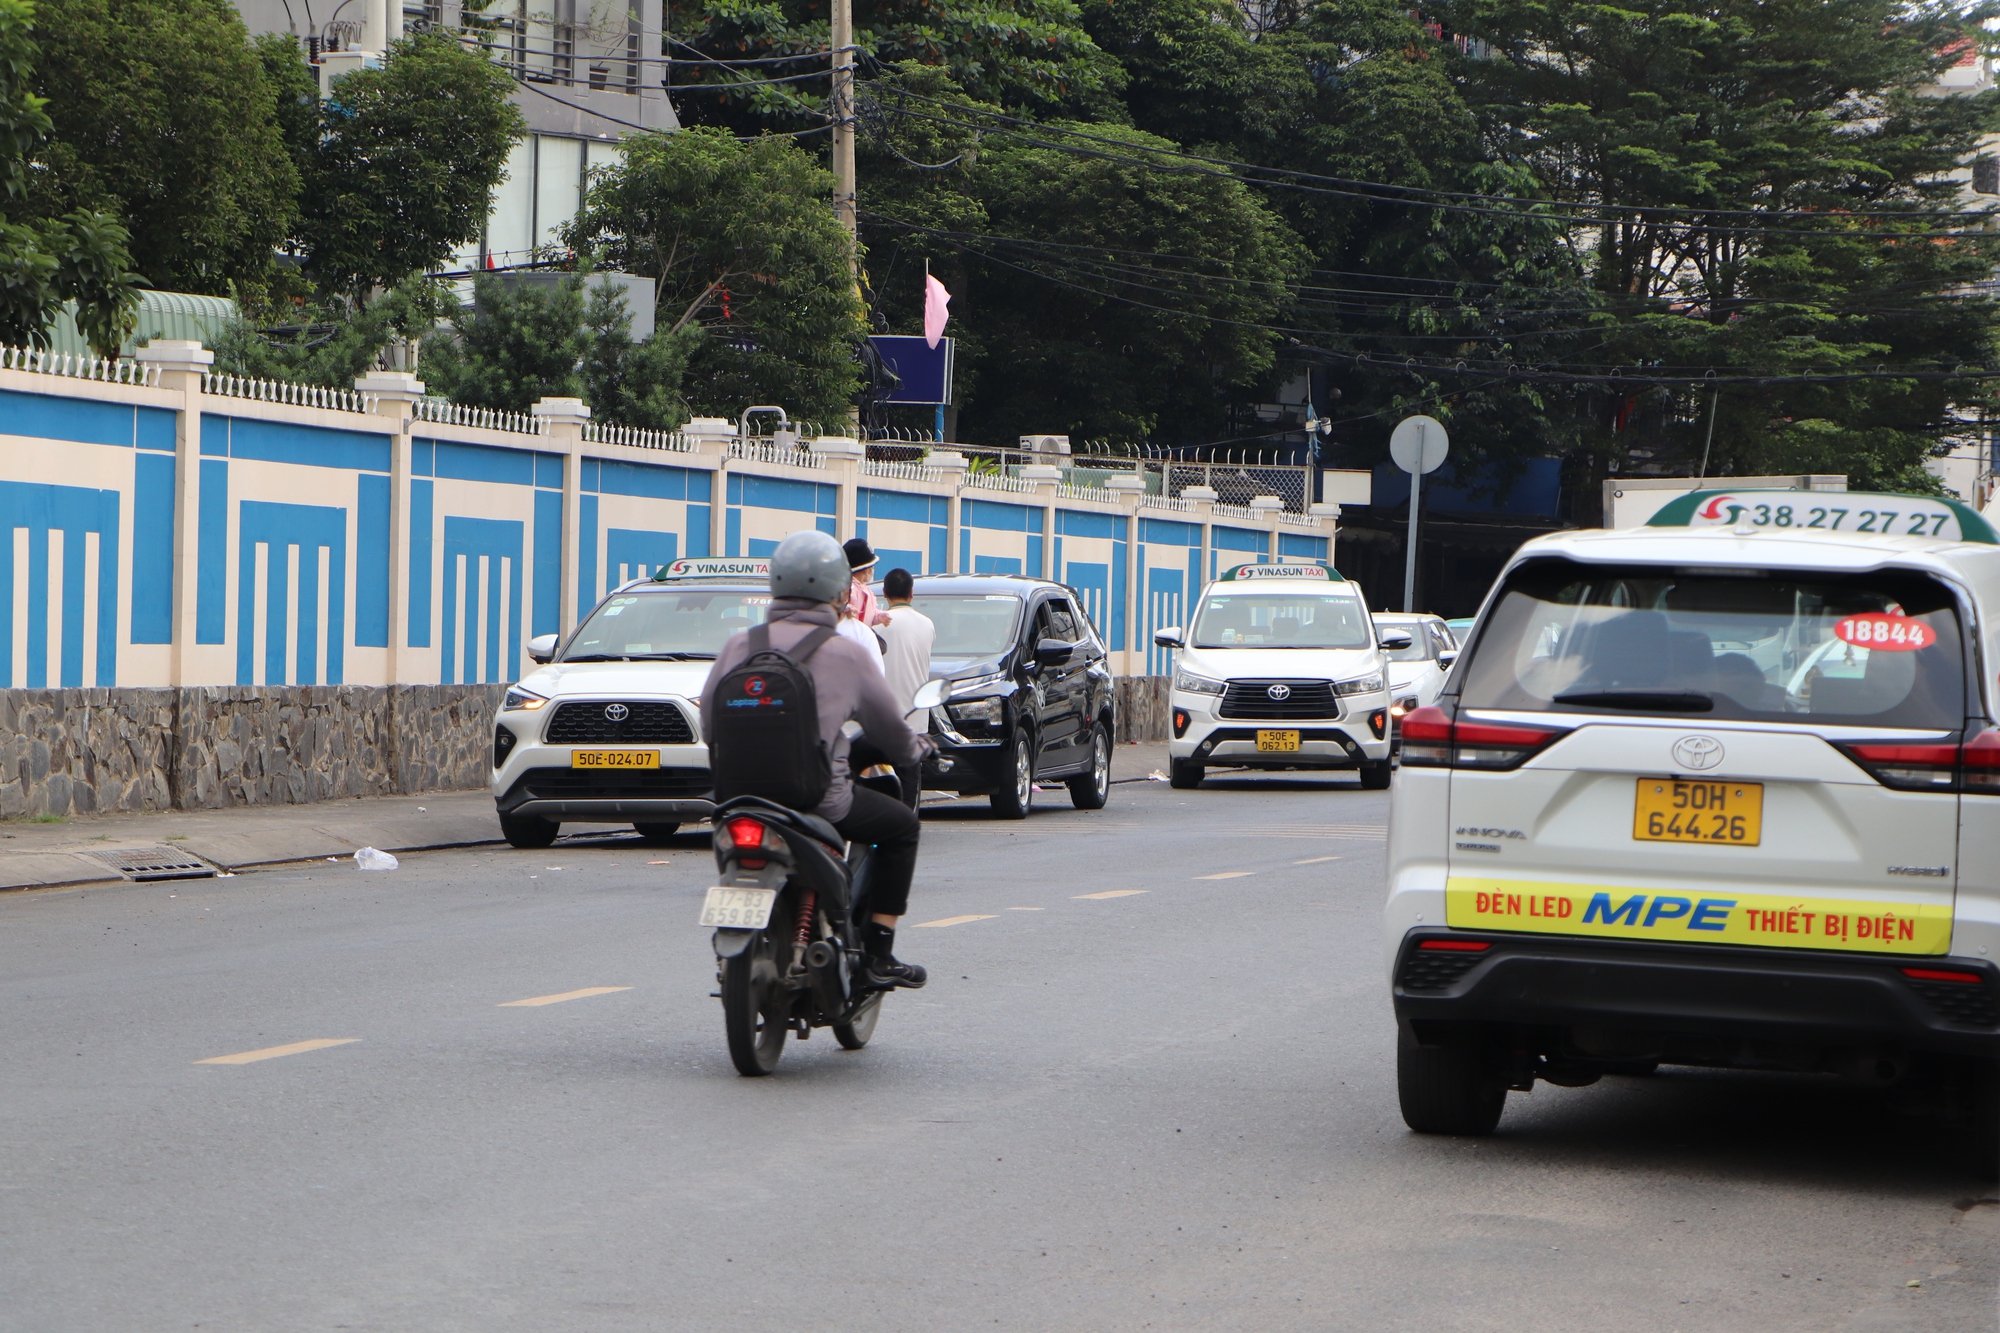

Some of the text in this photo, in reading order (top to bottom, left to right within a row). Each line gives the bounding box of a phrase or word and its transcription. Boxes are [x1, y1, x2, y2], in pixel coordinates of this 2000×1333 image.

[1857, 510, 1898, 534] 27
[1907, 512, 1949, 537] 27
[1842, 619, 1924, 646] 18844
[1261, 742, 1295, 750] 062.13
[1673, 784, 1727, 811] 50H
[1648, 812, 1747, 840] 644.26
[1476, 888, 1915, 944] ĐÈN LED MPE THIẾT BỊ ĐIỆN
